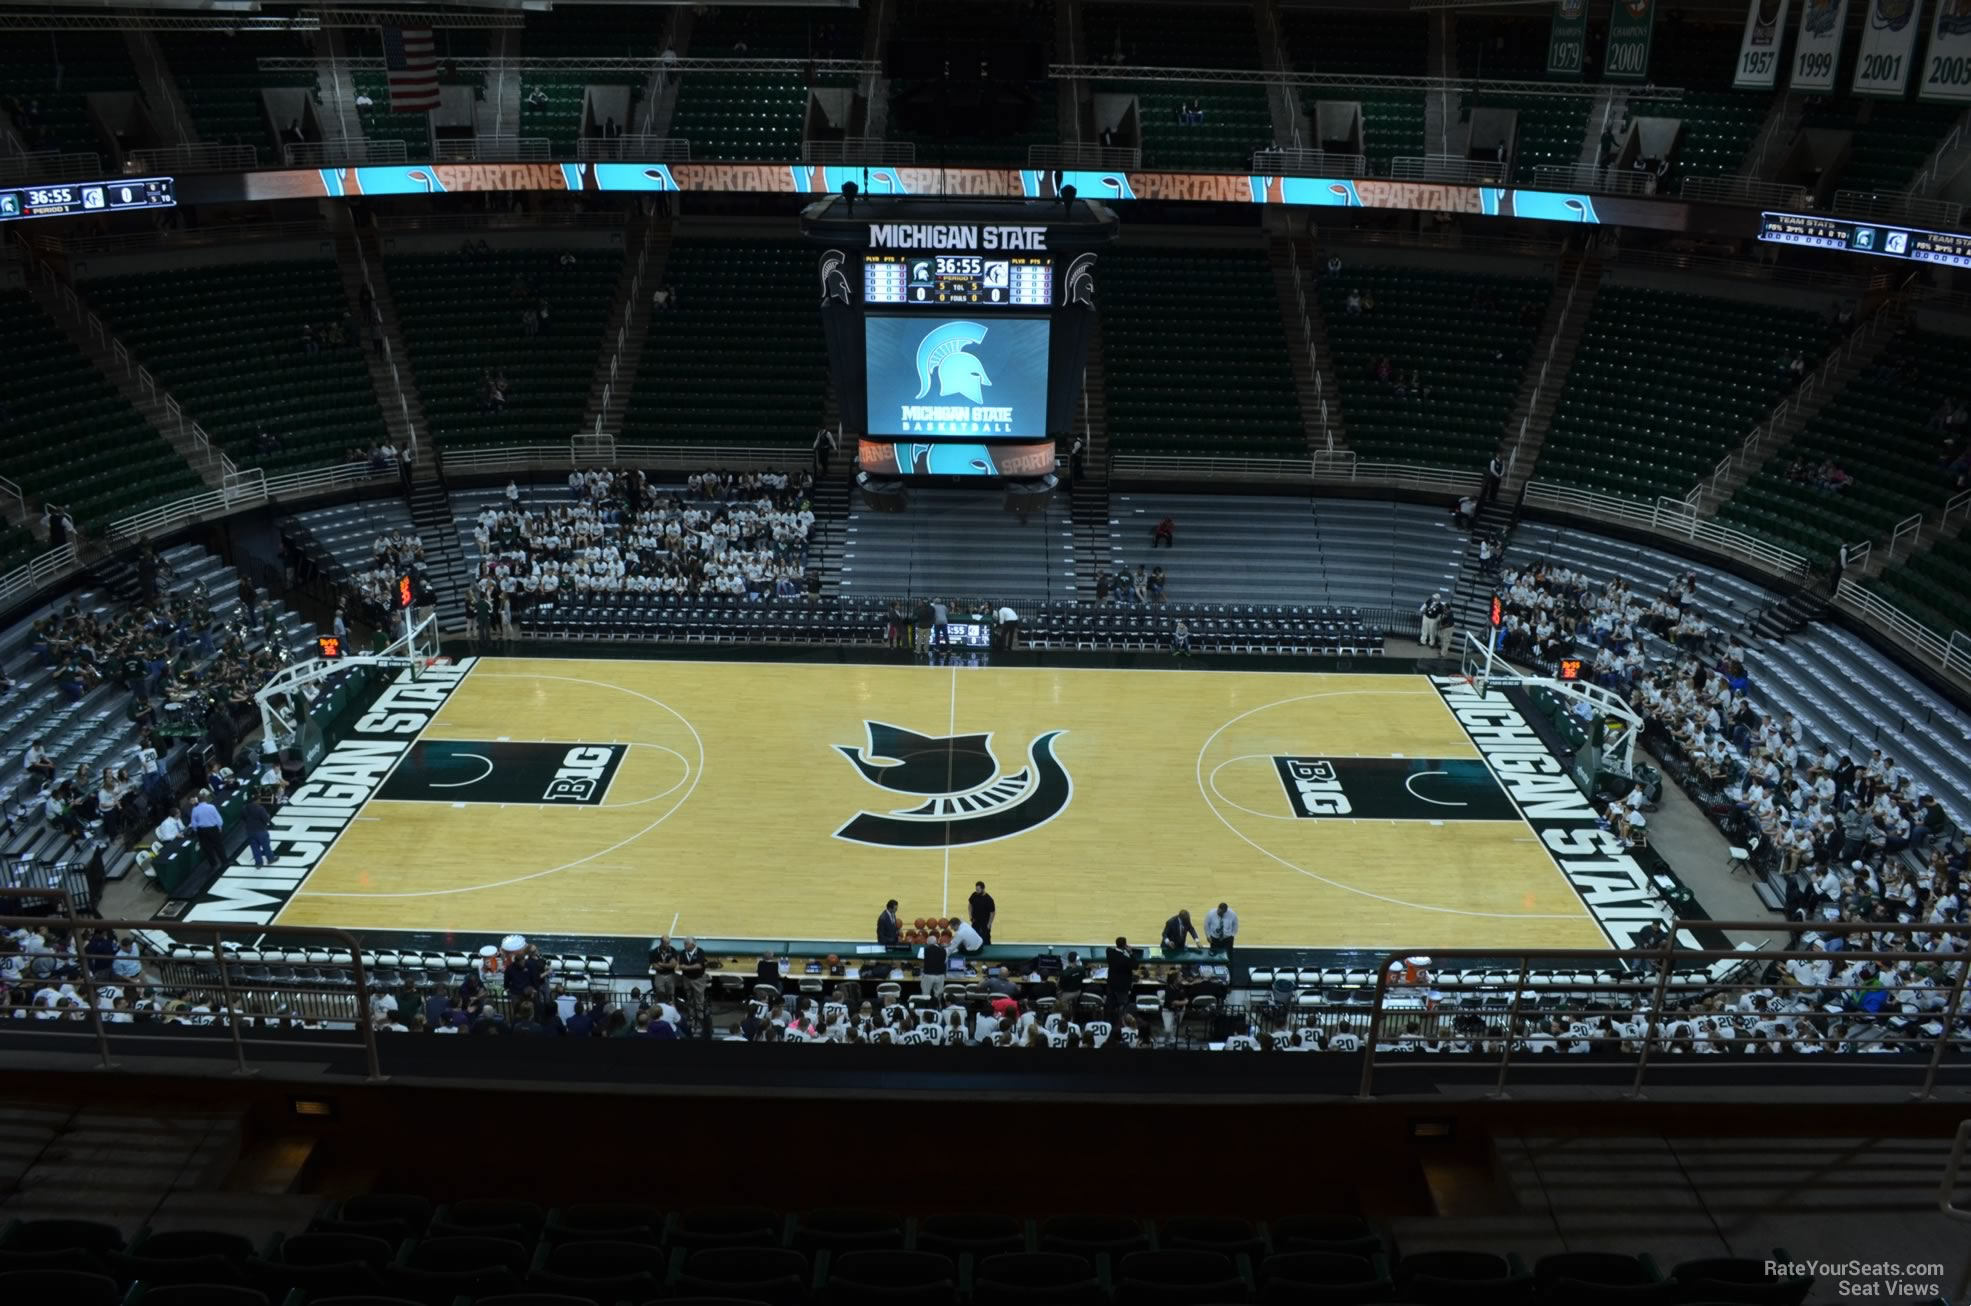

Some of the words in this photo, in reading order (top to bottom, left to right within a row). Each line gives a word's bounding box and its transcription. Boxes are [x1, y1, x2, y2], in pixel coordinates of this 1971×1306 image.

[1553, 42, 1580, 68] 1979
[1611, 42, 1644, 71] 2000
[1743, 52, 1774, 74] 1957
[1800, 53, 1832, 77] 1999
[1861, 54, 1902, 80] 2001
[1930, 56, 1971, 85] 2005
[441, 166, 563, 190] SPARTANS
[675, 166, 792, 191] SPARTANS
[901, 168, 1023, 197] SPARTANS
[1131, 174, 1250, 201] SPARTANS
[30, 189, 72, 204] 36:55
[121, 188, 132, 203] 0
[1360, 182, 1481, 213] SPARTANS
[33, 207, 64, 215] PERIOD
[1779, 216, 1804, 225] TEAM
[1806, 219, 1835, 229] STATS
[869, 224, 978, 249] MICHIGAN
[983, 226, 1048, 250] STATE
[1928, 234, 1953, 243] TEAM
[937, 259, 980, 273] 36:55
[917, 288, 925, 300] 0
[991, 289, 1000, 301] 0
[901, 406, 969, 422] MICHIGAN
[972, 407, 1013, 422] STATE
[903, 422, 1011, 432] BASKETBALL
[1430, 675, 1601, 818] MICHIGAN
[182, 740, 409, 925] MICHIGAN
[99, 988, 115, 998] 20
[827, 1006, 842, 1015] 20
[1771, 999, 1785, 1010] 20
[1718, 1017, 1733, 1028] 20
[922, 1027, 938, 1040] 20
[948, 1031, 964, 1041] 20
[1091, 1025, 1107, 1036] 20
[1305, 1030, 1320, 1042] 20
[1572, 1025, 1588, 1036] 20
[906, 1033, 921, 1045] 20
[1233, 1040, 1250, 1050] 20
[1274, 1036, 1289, 1049] 20
[1337, 1039, 1354, 1050] 20
